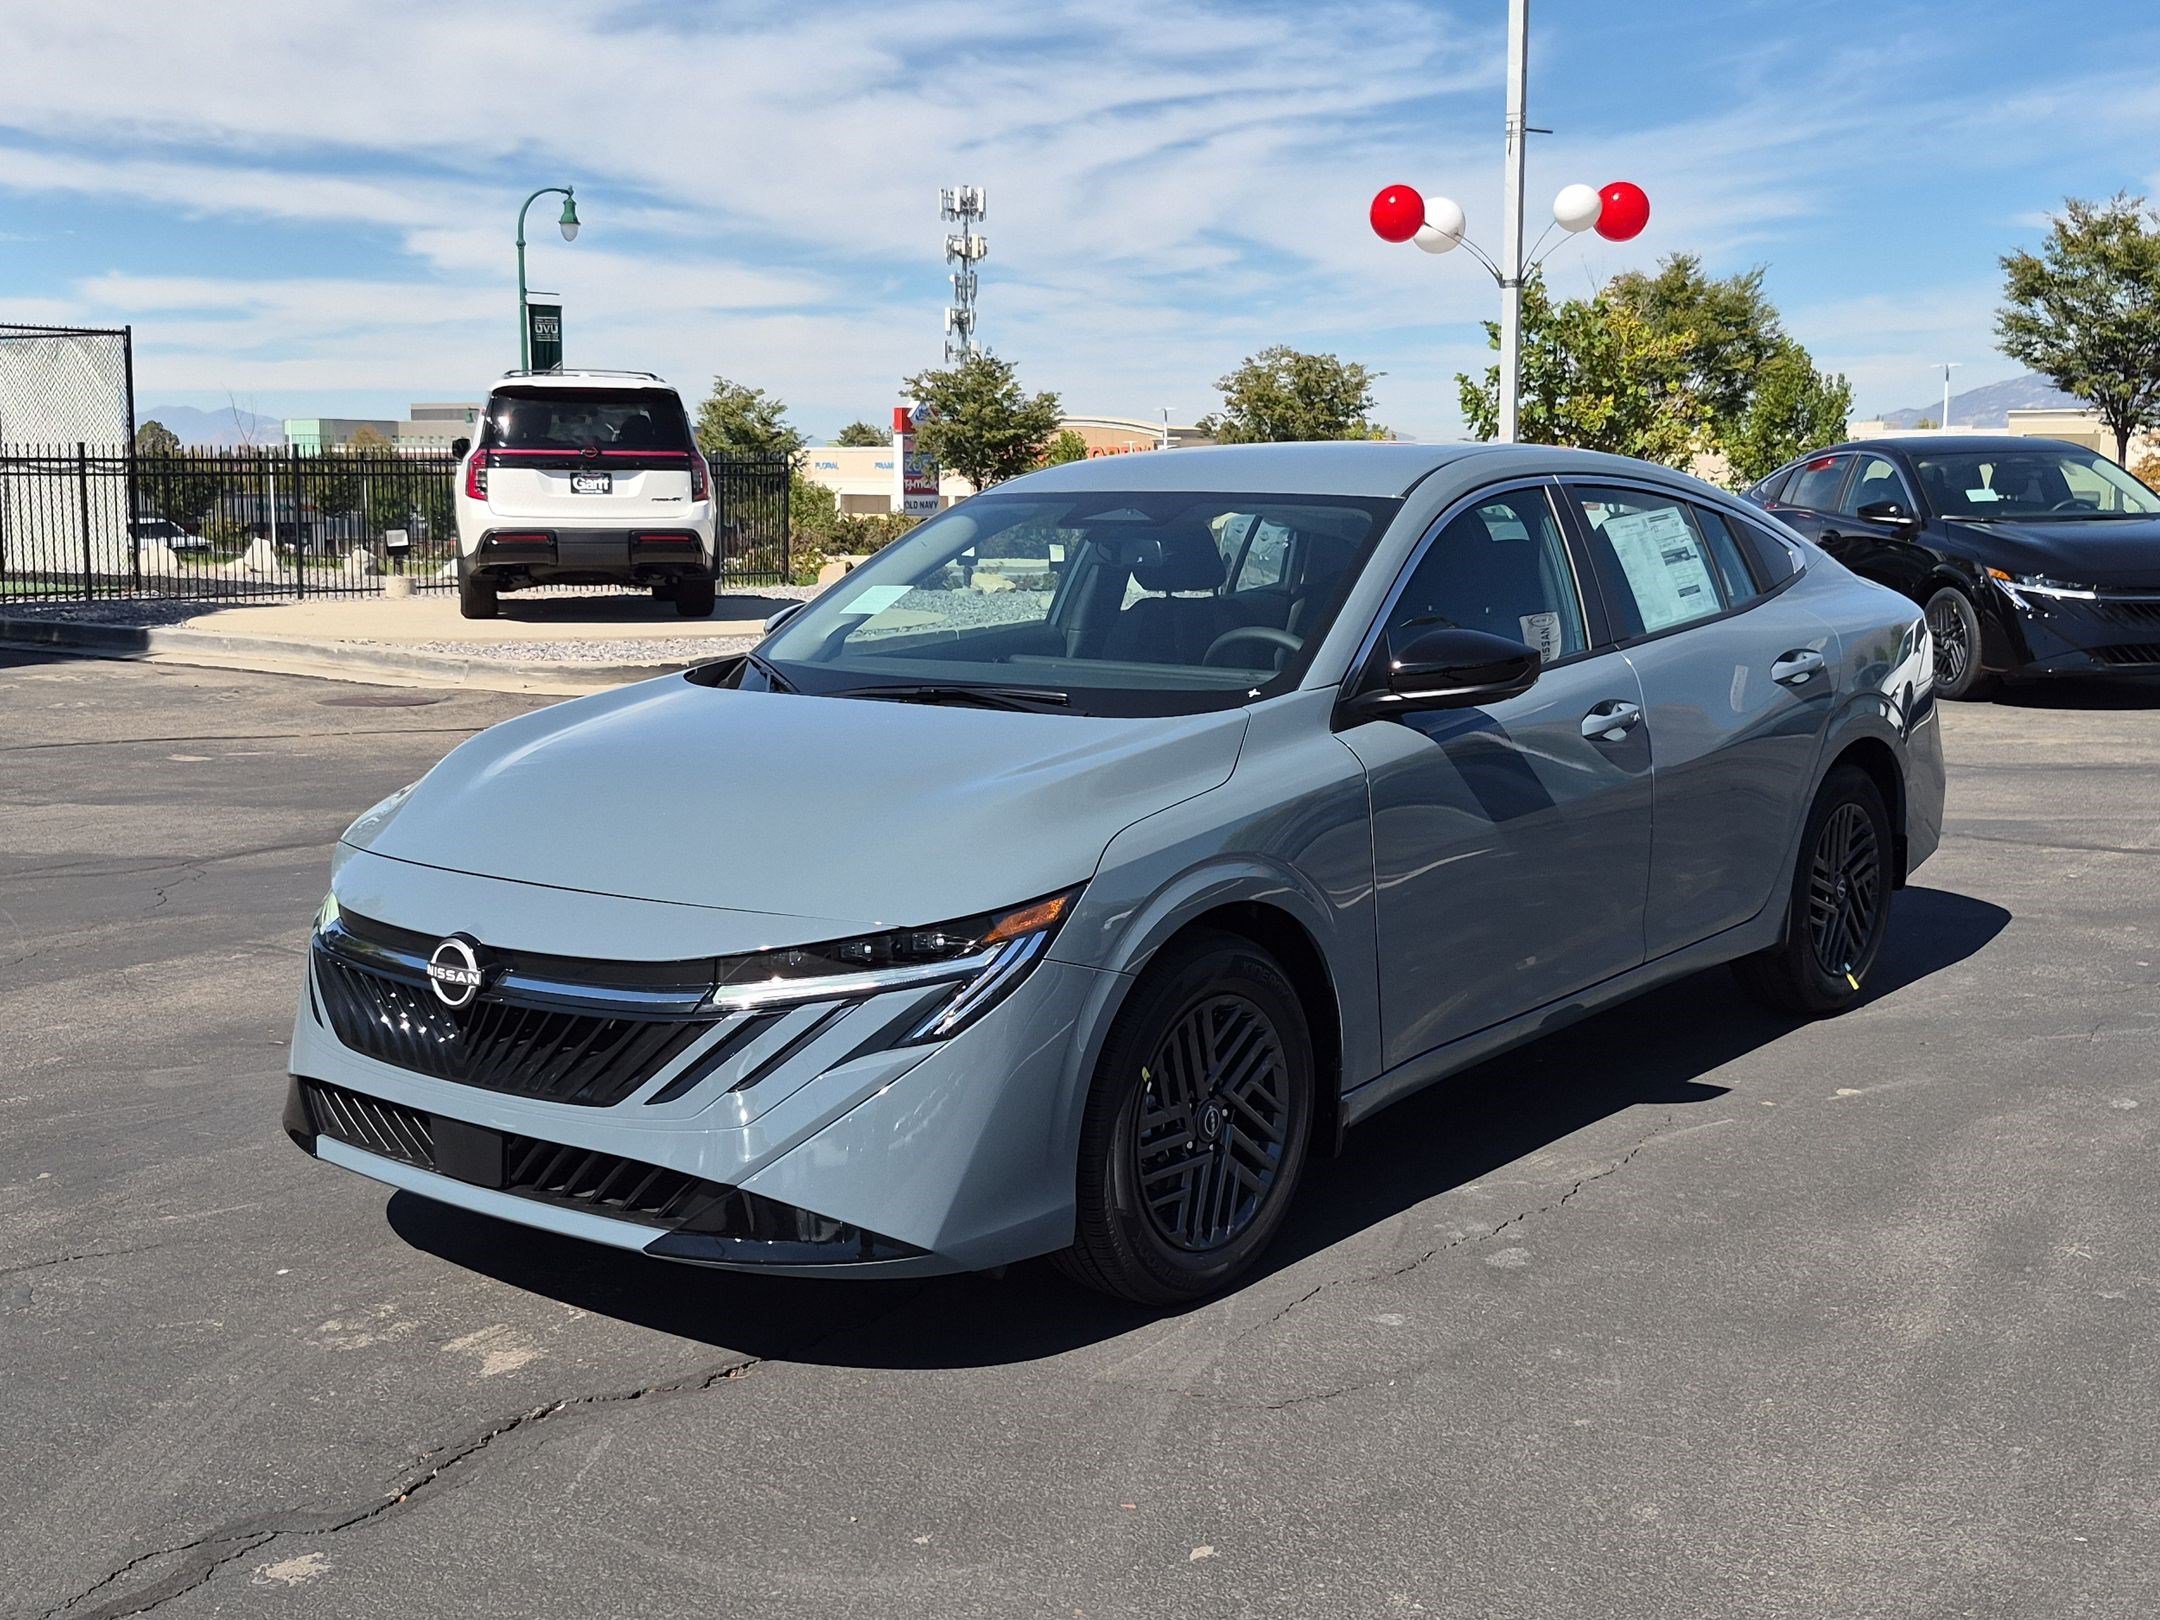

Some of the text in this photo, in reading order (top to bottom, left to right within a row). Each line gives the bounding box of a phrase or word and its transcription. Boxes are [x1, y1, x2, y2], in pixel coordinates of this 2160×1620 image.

[905, 500, 938, 510] OLD NAVY
[426, 963, 480, 985] NISSAN
